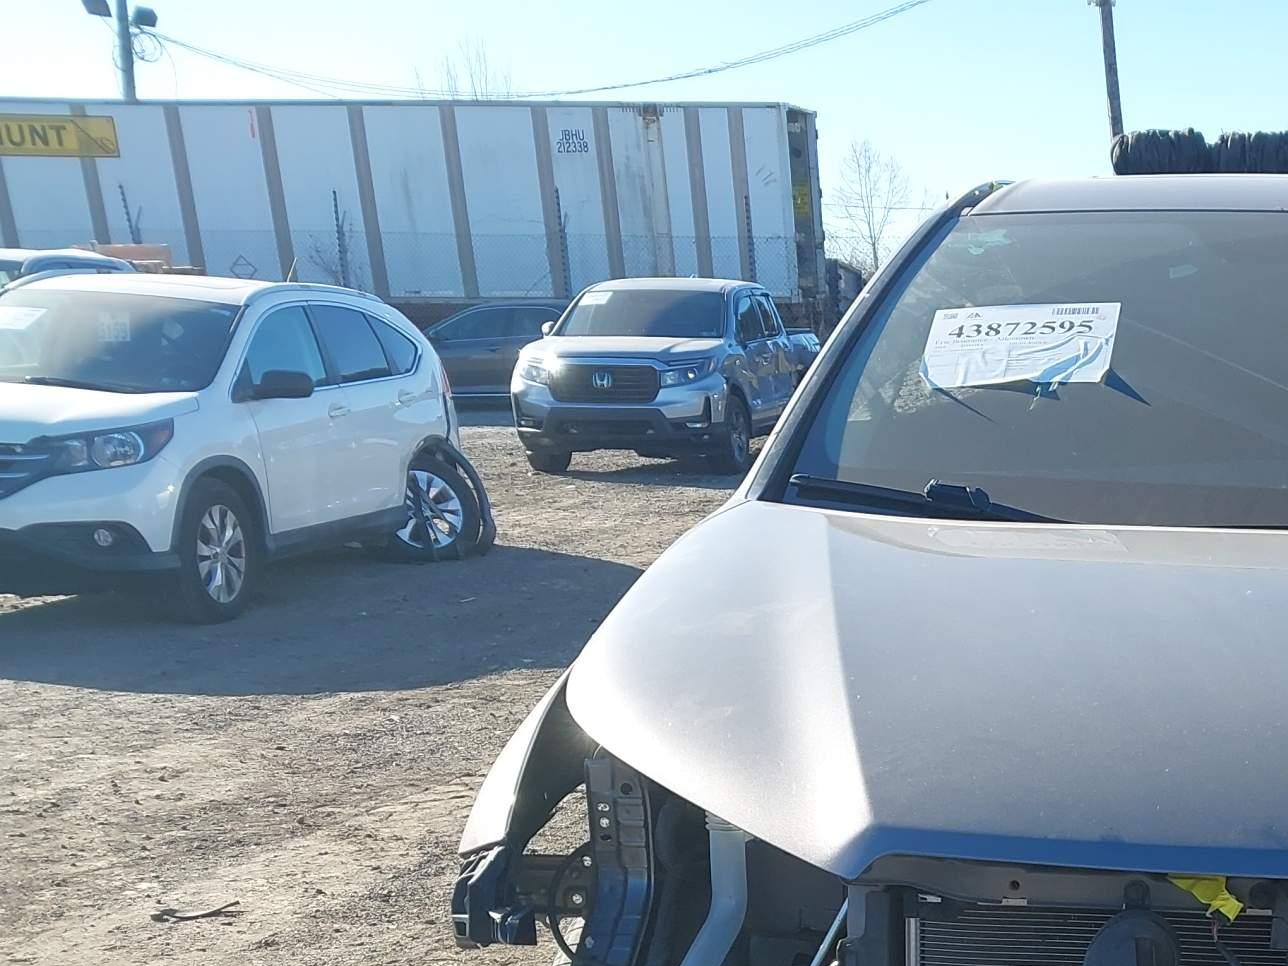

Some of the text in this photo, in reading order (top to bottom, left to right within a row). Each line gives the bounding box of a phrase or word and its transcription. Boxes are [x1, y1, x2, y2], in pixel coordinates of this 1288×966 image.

[0, 123, 67, 147] UNT
[559, 129, 585, 141] JBHU
[557, 141, 589, 153] 212338
[948, 319, 1094, 339] 43872595
